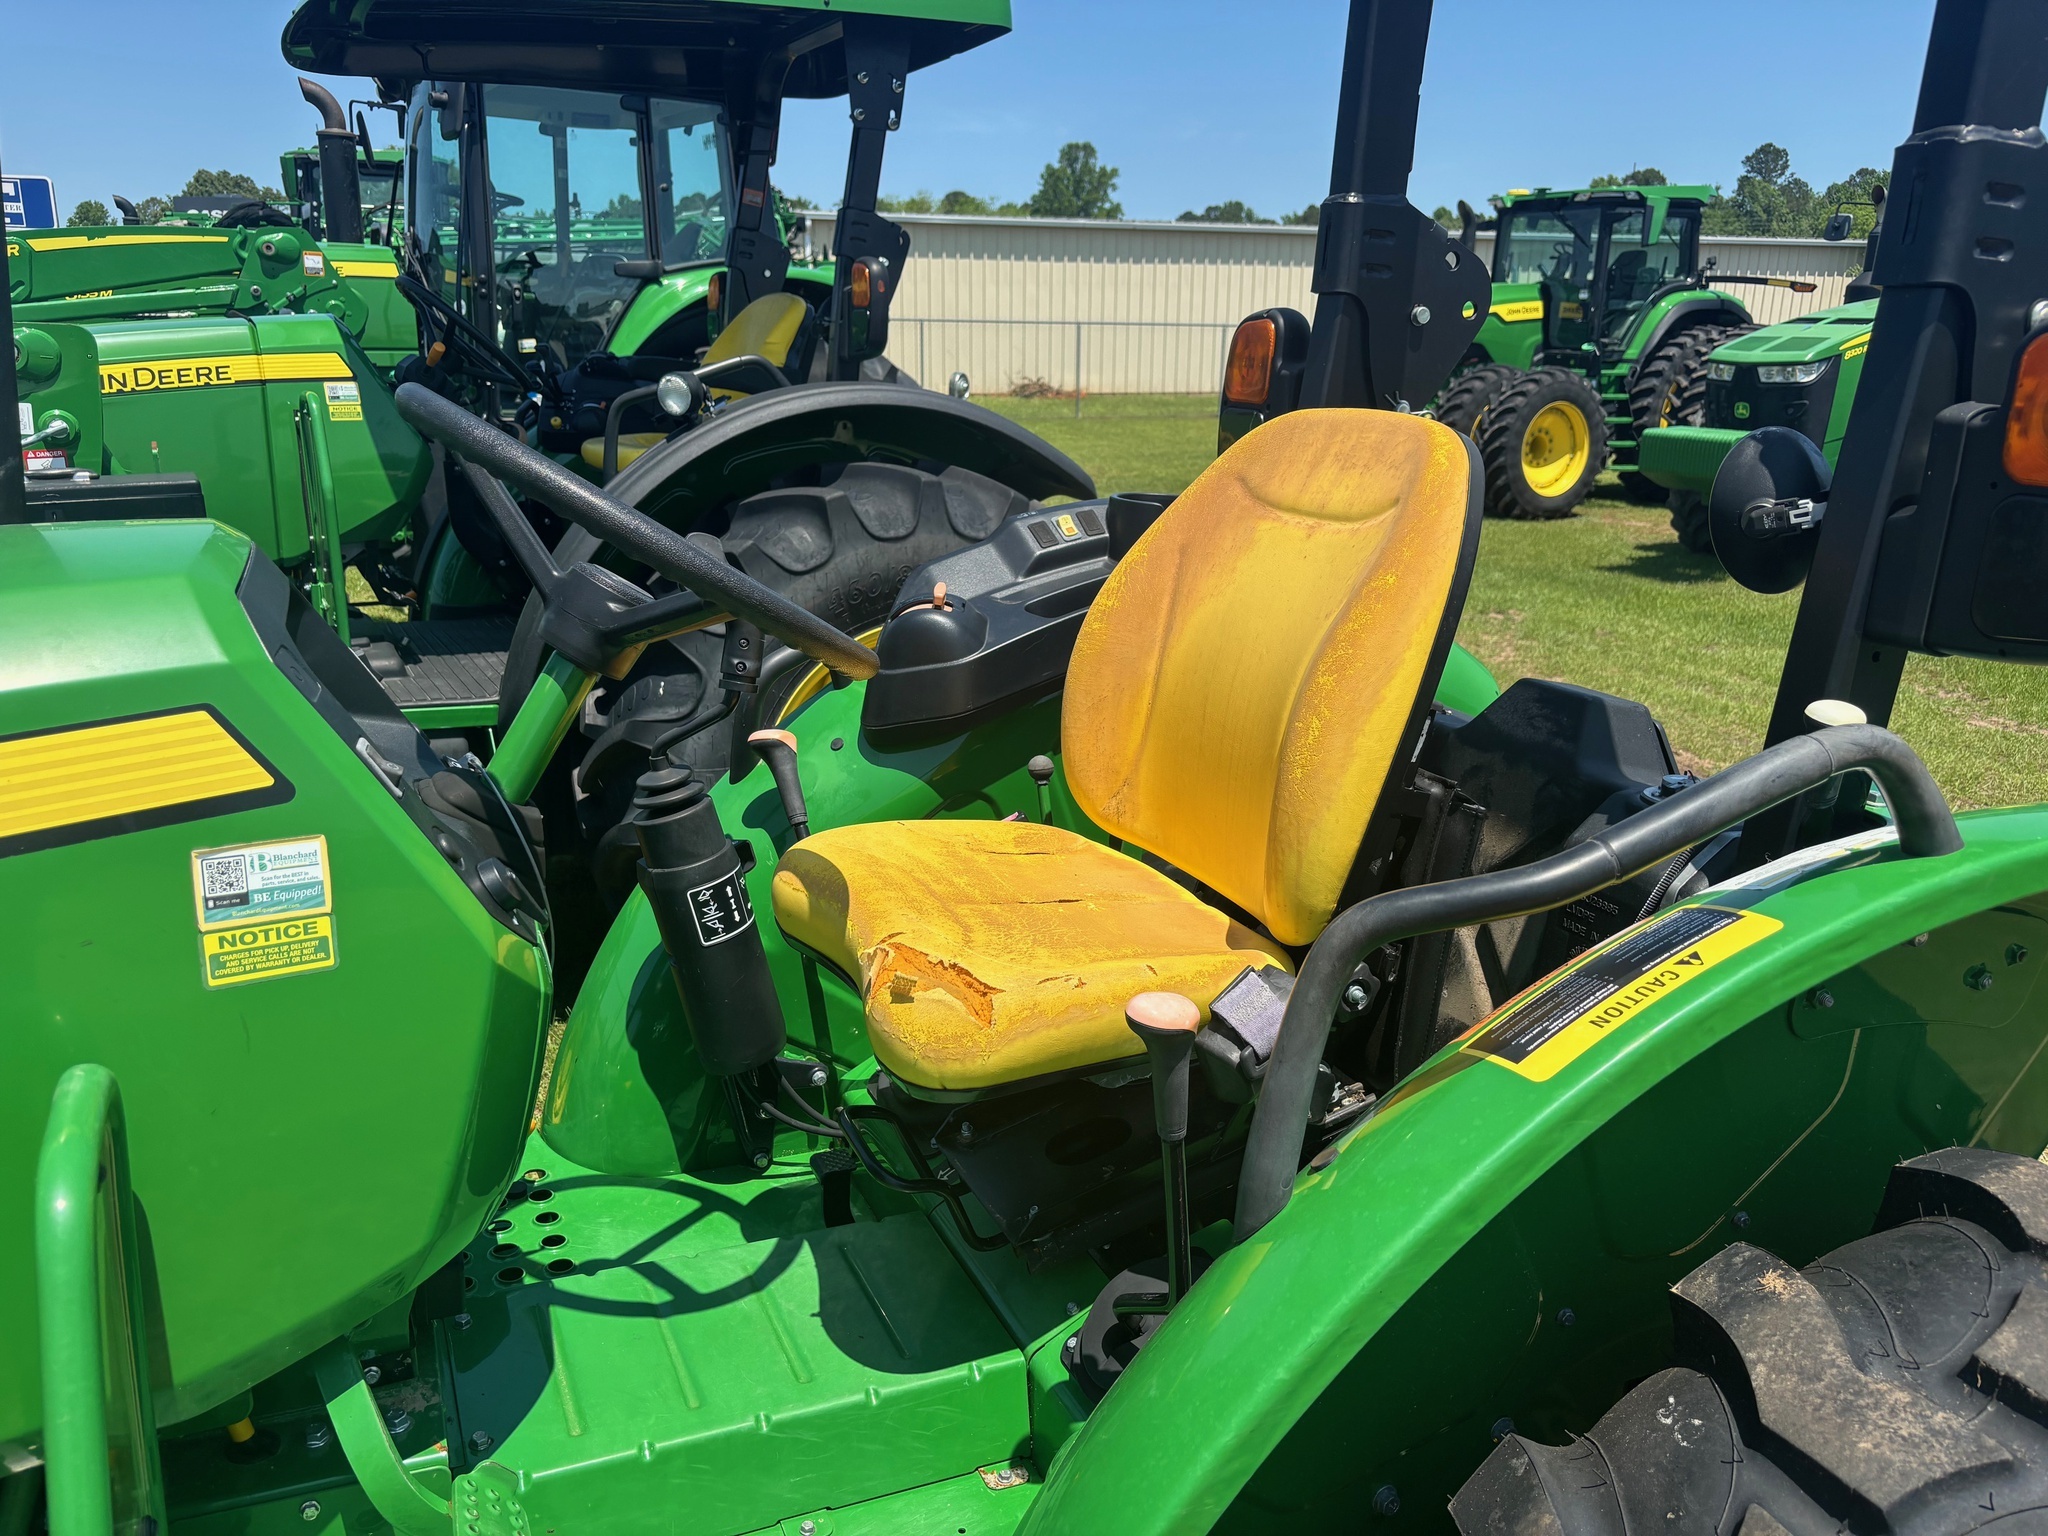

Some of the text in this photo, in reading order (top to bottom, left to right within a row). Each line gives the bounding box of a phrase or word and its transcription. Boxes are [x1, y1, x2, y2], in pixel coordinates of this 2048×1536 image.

[132, 365, 233, 387] DEERE
[35, 450, 63, 458] DANGER
[273, 850, 318, 862] Blanchard
[273, 857, 318, 866] EQUIPMENT
[254, 885, 322, 903] BE Equipped!
[218, 921, 318, 950] NOTICE
[219, 951, 250, 962] CHARGES
[251, 949, 264, 958] FOR
[265, 947, 279, 955] PICK
[290, 940, 319, 951] DELIVERY
[226, 960, 240, 968] AND
[241, 956, 267, 965] SERVICE
[268, 952, 289, 961] CALLS
[302, 947, 315, 955] NOT
[215, 966, 244, 976] COVERED
[256, 958, 291, 970] WARRANTY
[302, 952, 327, 961] DEALER.
[1588, 970, 1680, 1029] CAUTION
